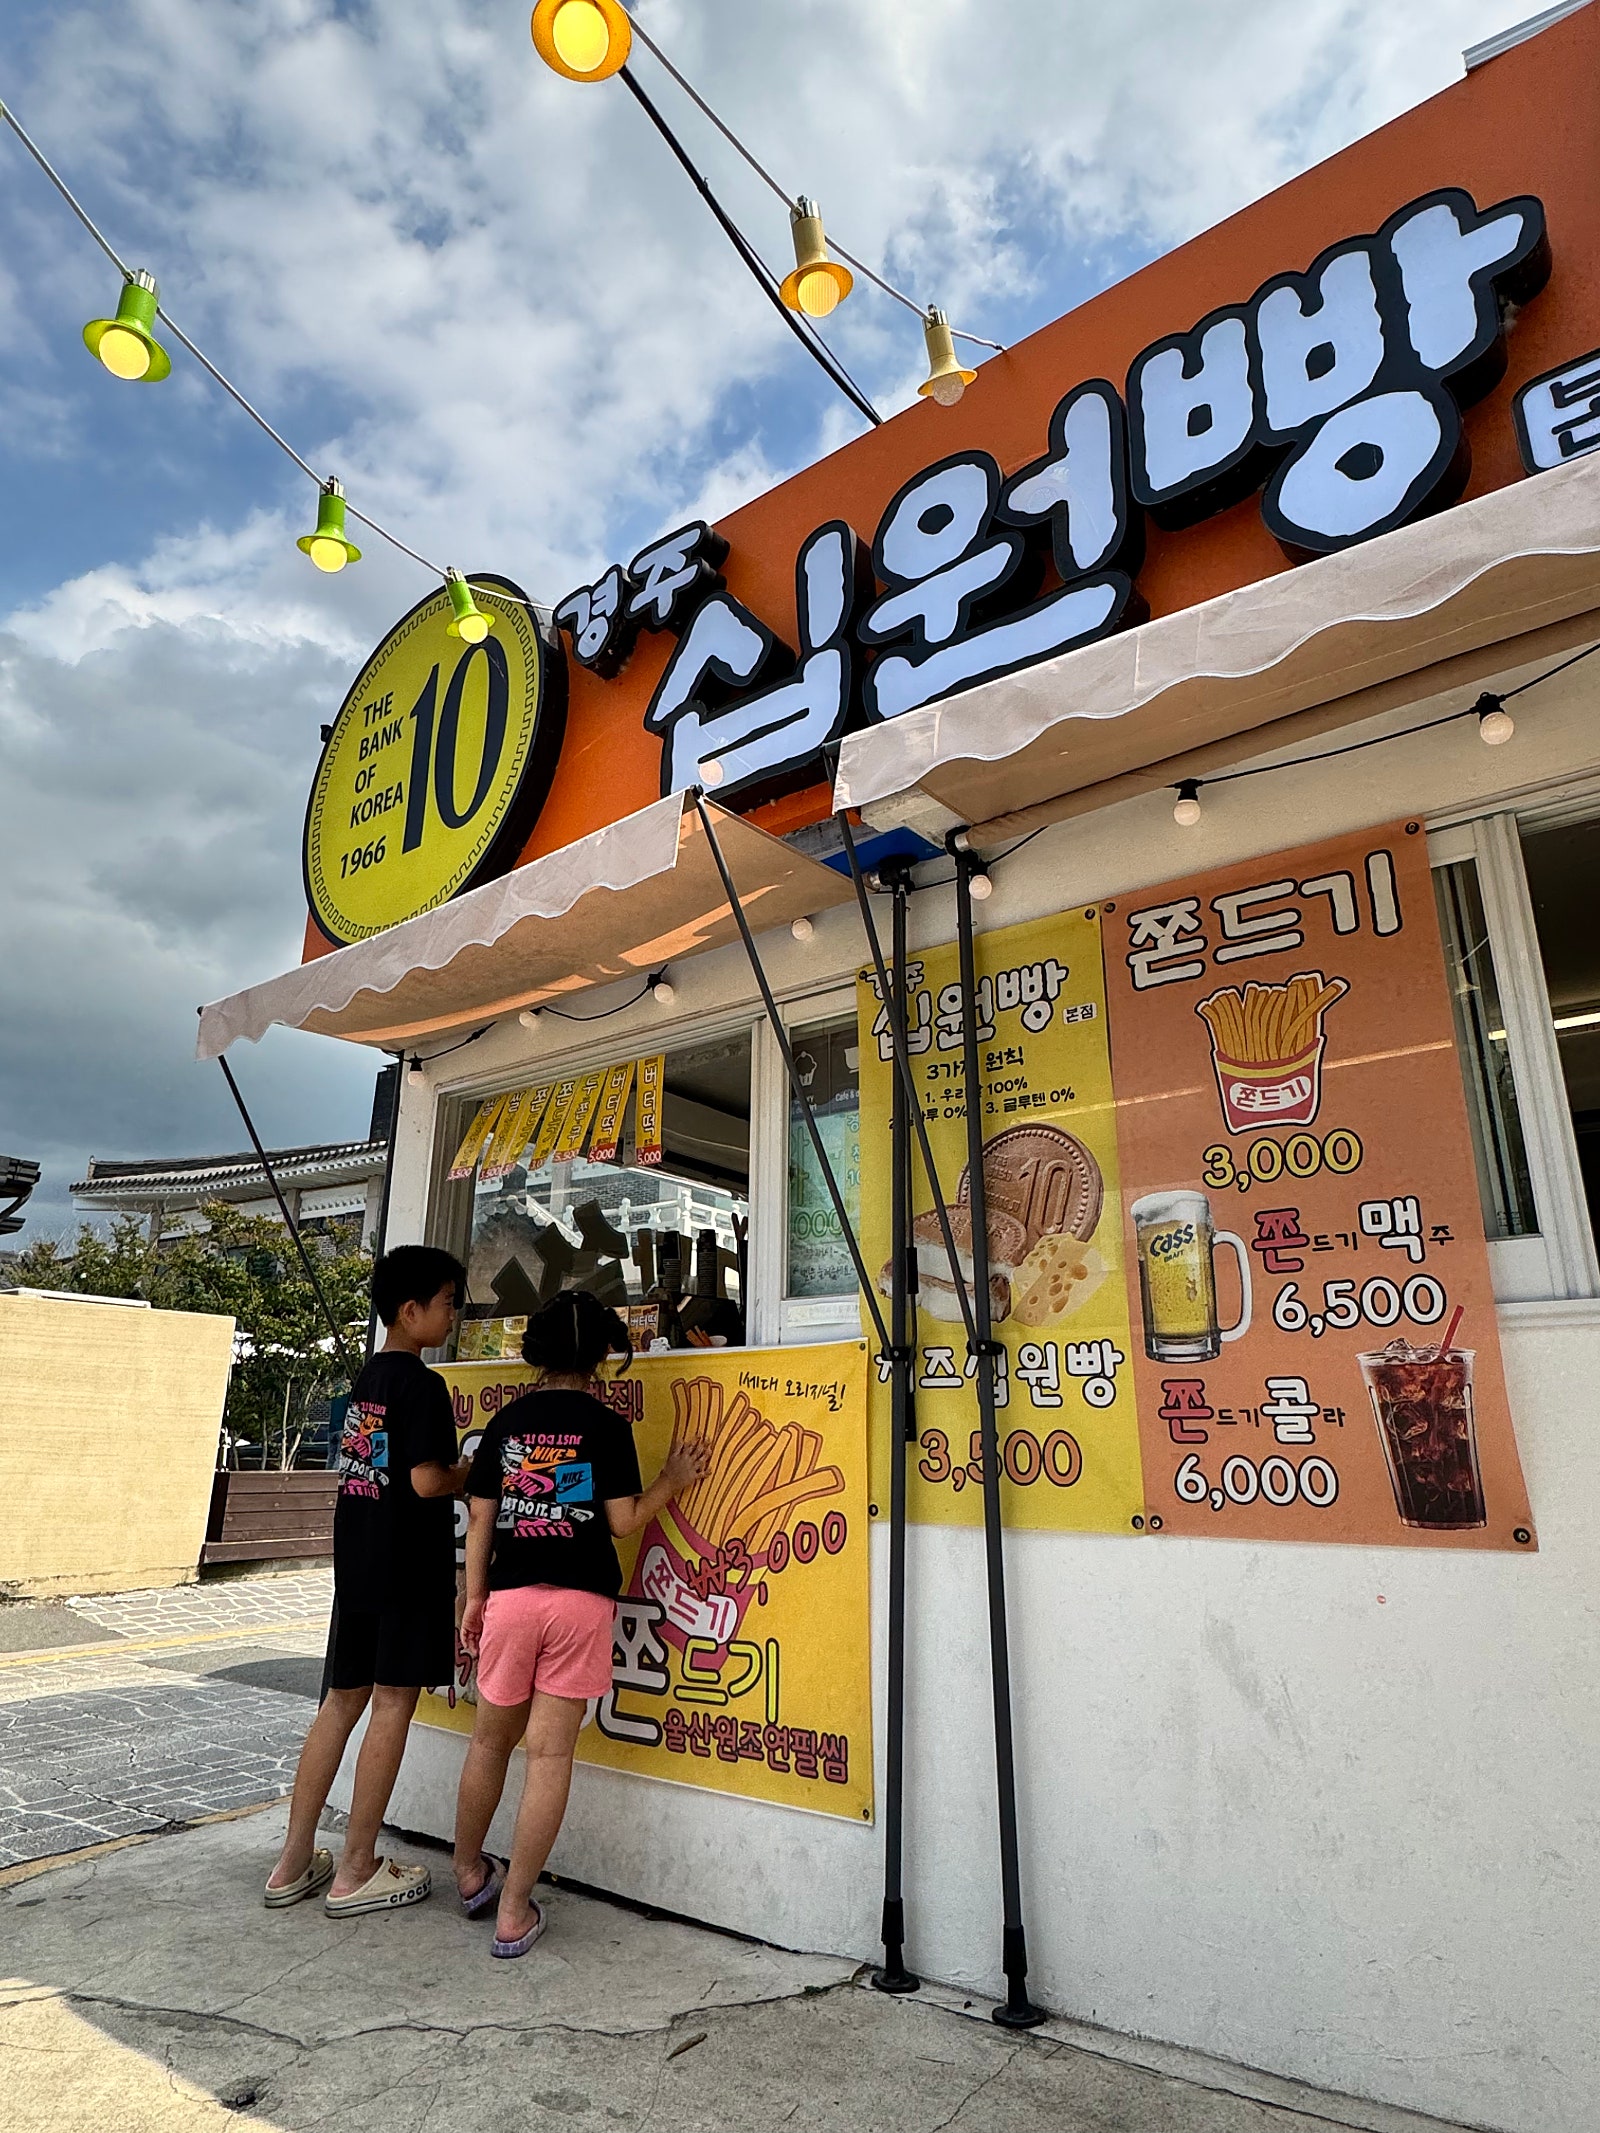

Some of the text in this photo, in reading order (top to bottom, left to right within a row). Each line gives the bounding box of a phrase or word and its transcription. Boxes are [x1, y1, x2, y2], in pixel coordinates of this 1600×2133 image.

[554, 192, 1538, 800] 경주 십원빵
[363, 691, 394, 728] THE
[358, 716, 404, 762] BANK
[401, 635, 509, 856] 10
[354, 763, 376, 794] OF
[349, 780, 404, 829] KOREA
[339, 835, 387, 879] 1966
[1126, 849, 1403, 991] 쫀드기
[1064, 1003, 1094, 1024] 본점
[985, 1046, 1025, 1073] 원칙
[925, 1092, 936, 1104] 1.
[987, 1076, 1028, 1096] 100%
[985, 1101, 999, 1115] 3.
[1050, 1086, 1075, 1103] 0%
[1237, 1079, 1308, 1108] 쫀드기
[1203, 1127, 1363, 1192] 3,000
[1273, 1273, 1447, 1338] 6,500
[530, 1446, 567, 1462] NIKE
[919, 1428, 1083, 1492] 3,500
[561, 1470, 586, 1485] NIKE
[1174, 1453, 1339, 1511] 6,000
[662, 1707, 849, 1785] 울산원조연필씸
